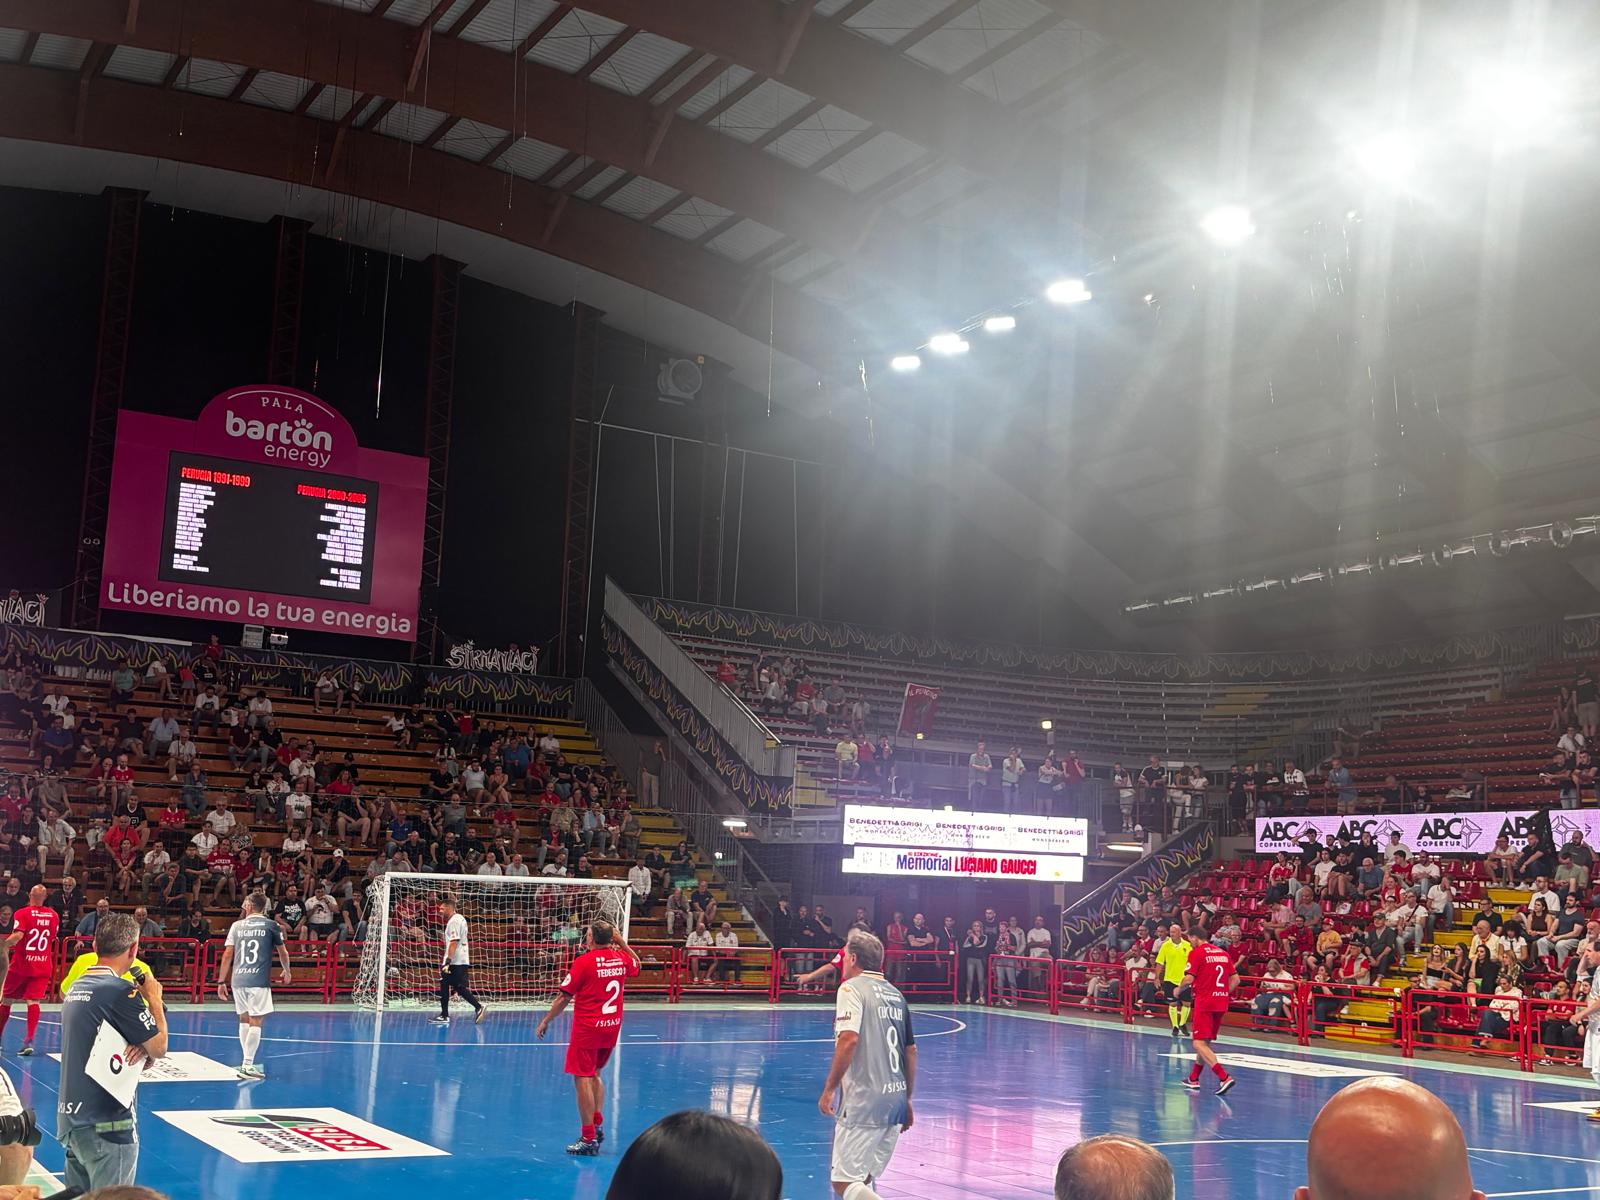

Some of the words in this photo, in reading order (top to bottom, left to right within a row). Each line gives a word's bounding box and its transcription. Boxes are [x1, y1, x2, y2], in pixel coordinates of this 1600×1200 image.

[261, 397, 303, 413] PALA
[264, 444, 331, 468] energy
[181, 467, 212, 482] PERUGIA
[213, 471, 251, 487] 1991-1999
[297, 484, 326, 499] PERUGIA
[107, 582, 240, 616] Liberiamo
[248, 597, 269, 619] la
[276, 602, 315, 623] tua
[321, 607, 411, 635] energia
[1259, 821, 1300, 841] ABC
[1417, 818, 1462, 840] ABC
[896, 855, 952, 872] Memorial
[954, 856, 997, 874] LUCIANO
[1001, 859, 1037, 876] GAUCCI
[25, 928, 51, 951] 26
[240, 939, 259, 965] 13
[597, 967, 623, 978] TEDESCO
[1215, 965, 1225, 987] 2
[602, 980, 620, 1014] 2
[886, 1026, 900, 1073] 8
